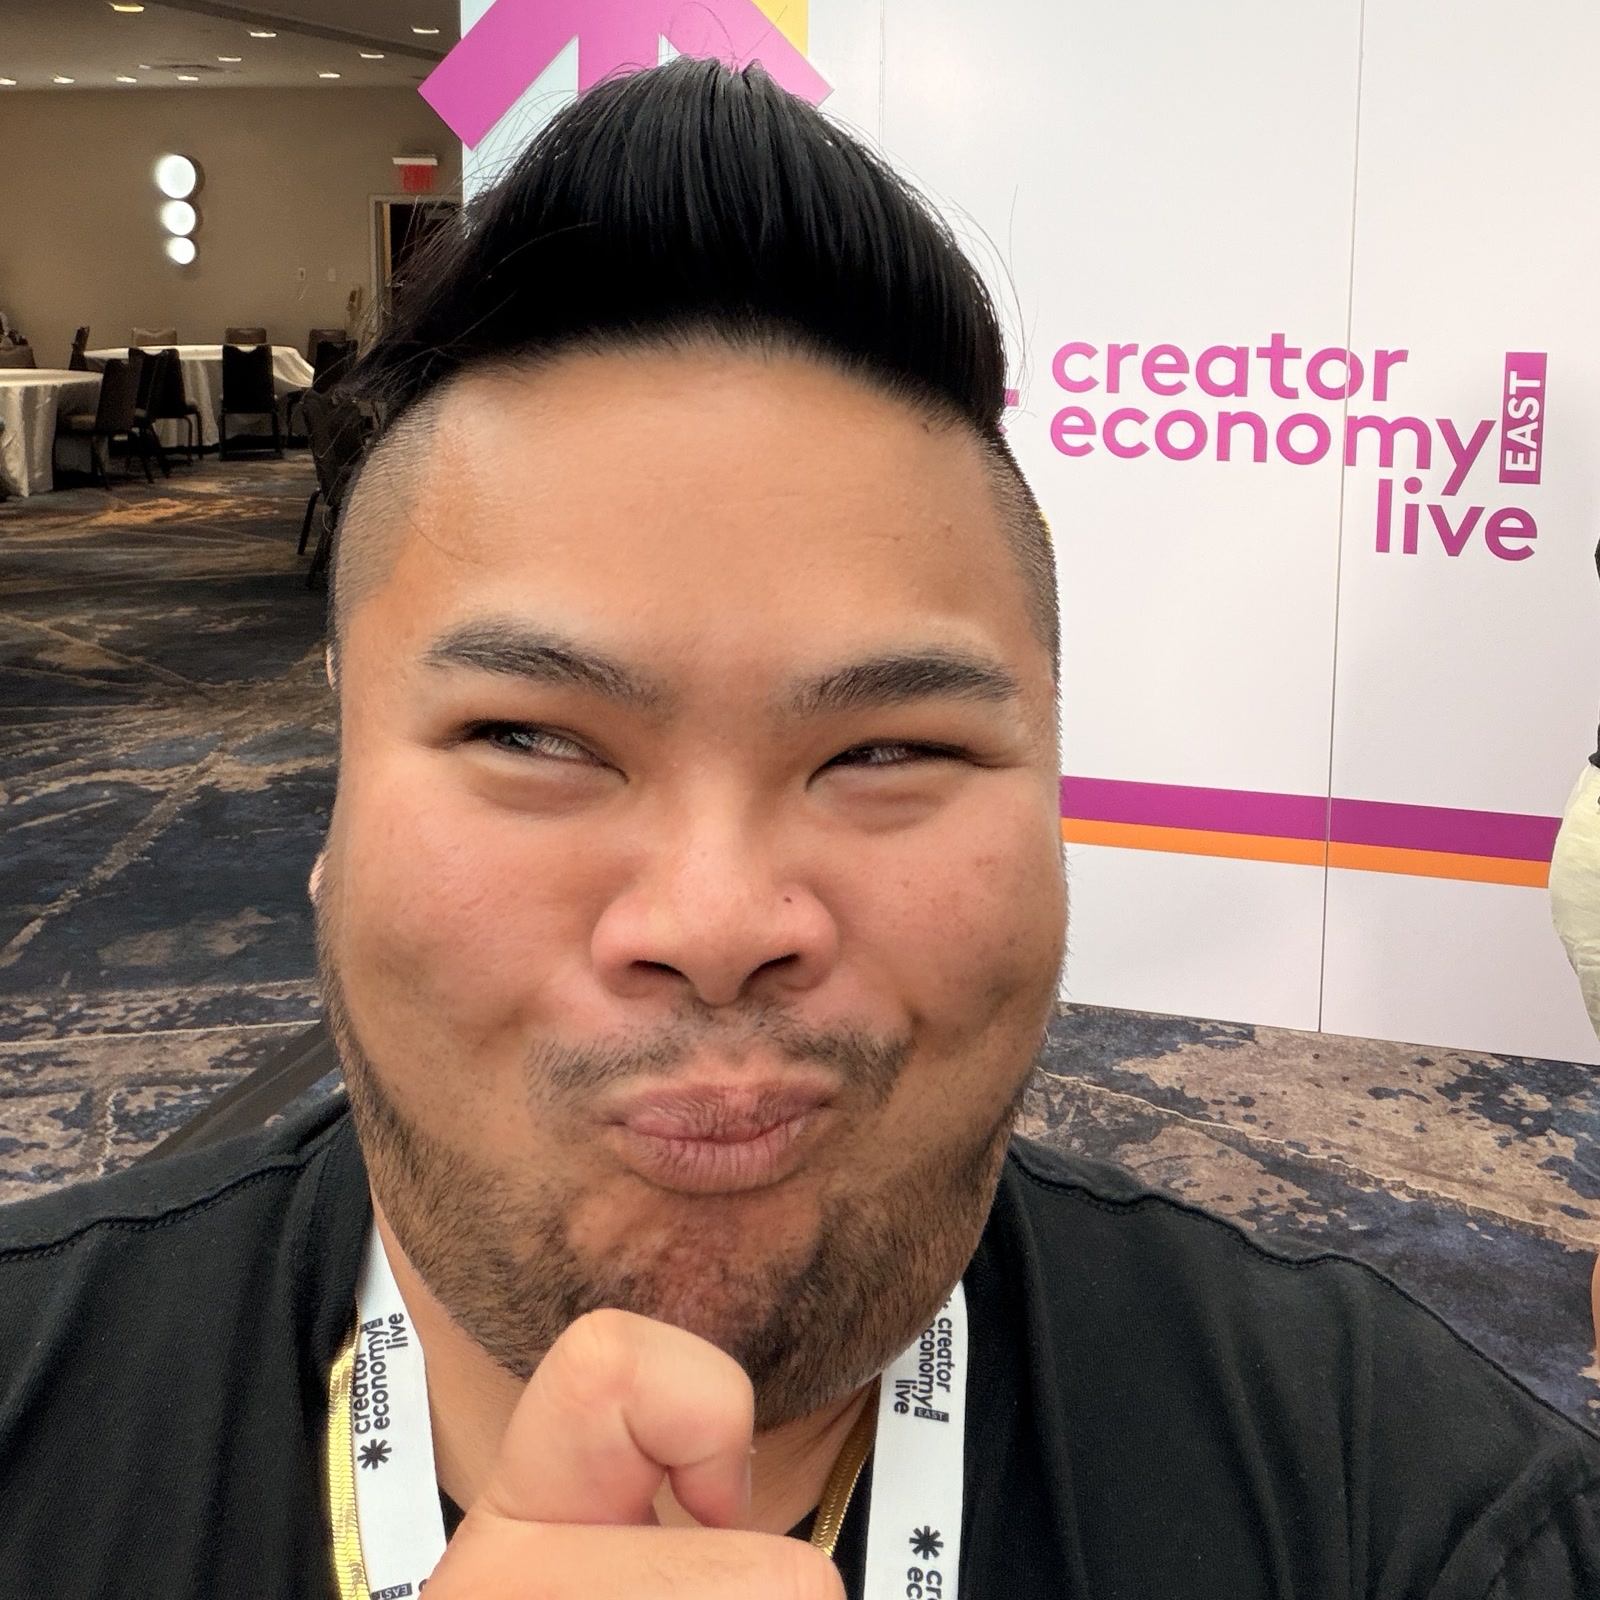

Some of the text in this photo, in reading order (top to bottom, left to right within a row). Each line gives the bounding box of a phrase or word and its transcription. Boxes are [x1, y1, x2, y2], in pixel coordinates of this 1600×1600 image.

[1052, 333, 1409, 401] creator
[1050, 405, 1497, 496] economy
[1505, 371, 1542, 473] EAST
[1375, 476, 1538, 561] live
[385, 1312, 408, 1350] live
[936, 1317, 956, 1393] creator
[366, 1330, 391, 1430] economy
[894, 1380, 918, 1415] live
[917, 1408, 945, 1421] EAST
[378, 1585, 408, 1600] EAST
